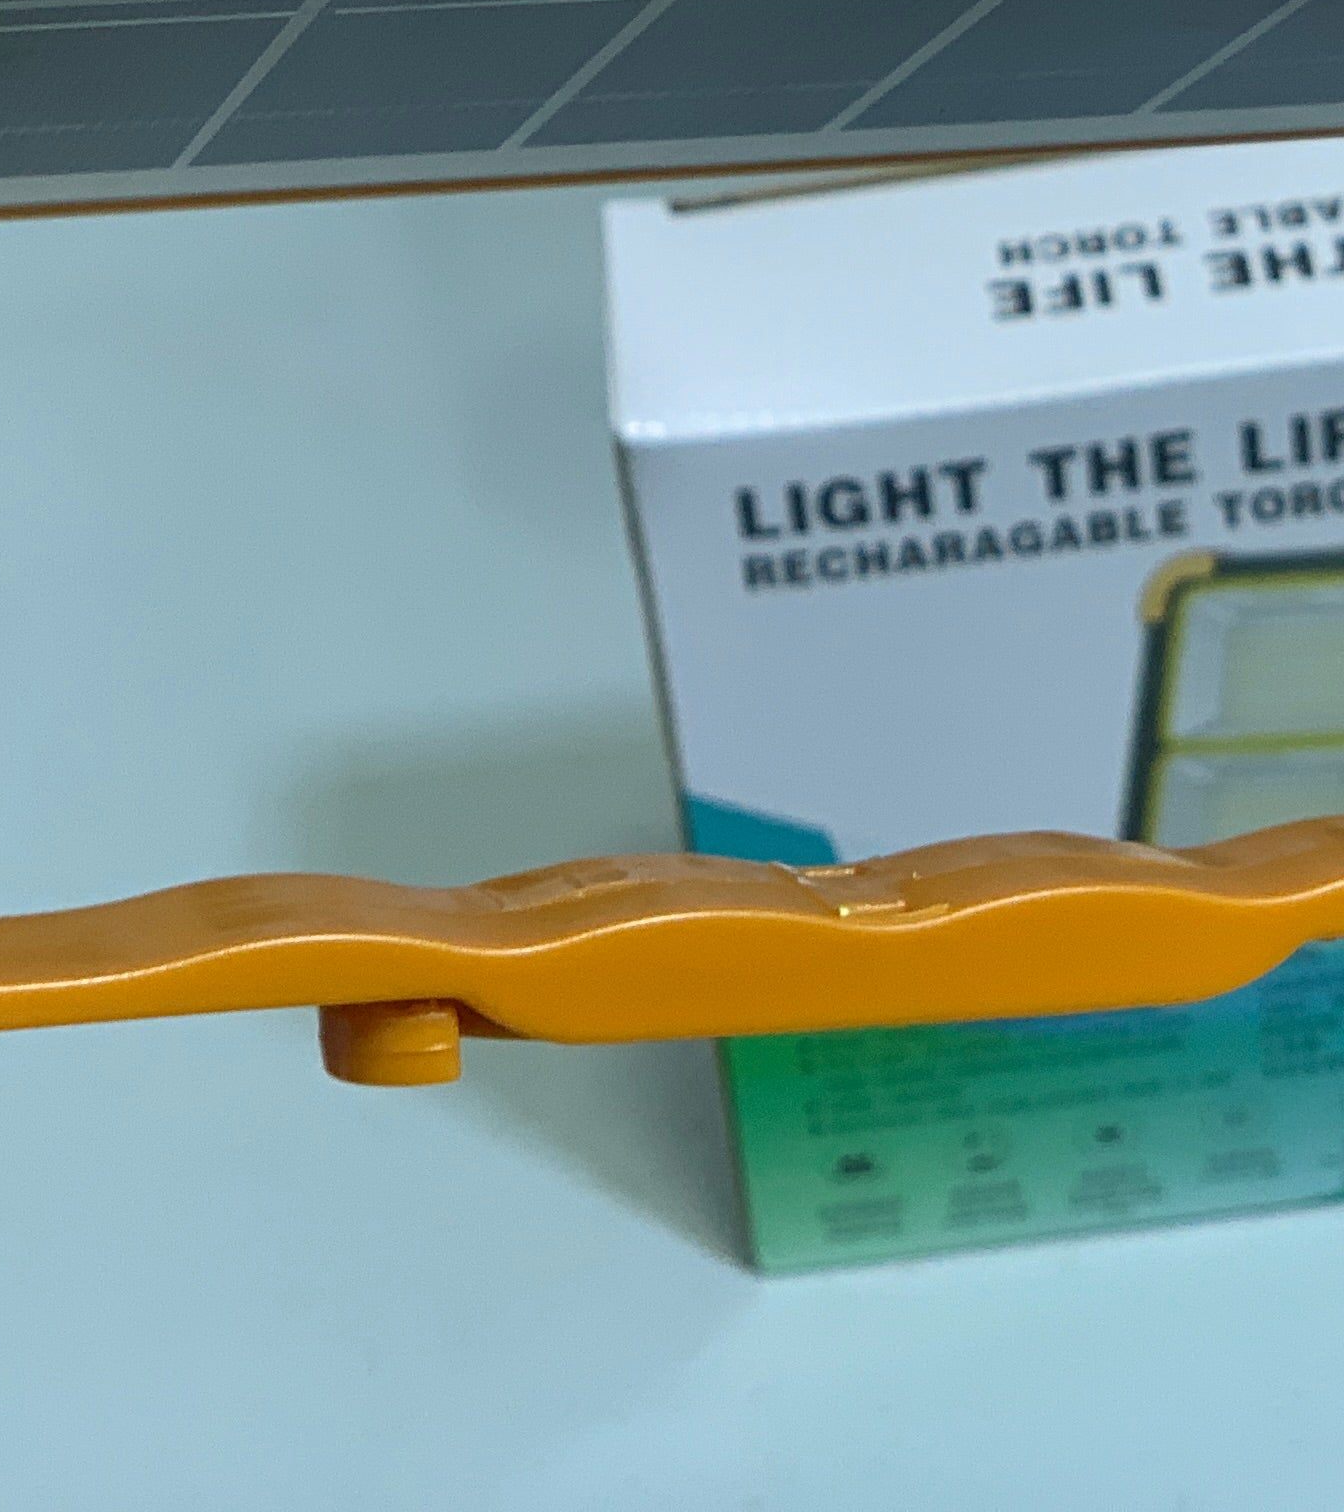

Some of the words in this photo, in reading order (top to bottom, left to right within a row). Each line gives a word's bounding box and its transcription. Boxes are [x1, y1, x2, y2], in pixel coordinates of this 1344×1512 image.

[998, 218, 1179, 269] TORCH
[989, 260, 1165, 321] LIFE
[735, 456, 989, 540] LIGHT
[1029, 428, 1197, 503] THE
[742, 499, 1192, 593] RECHARAGABLE
